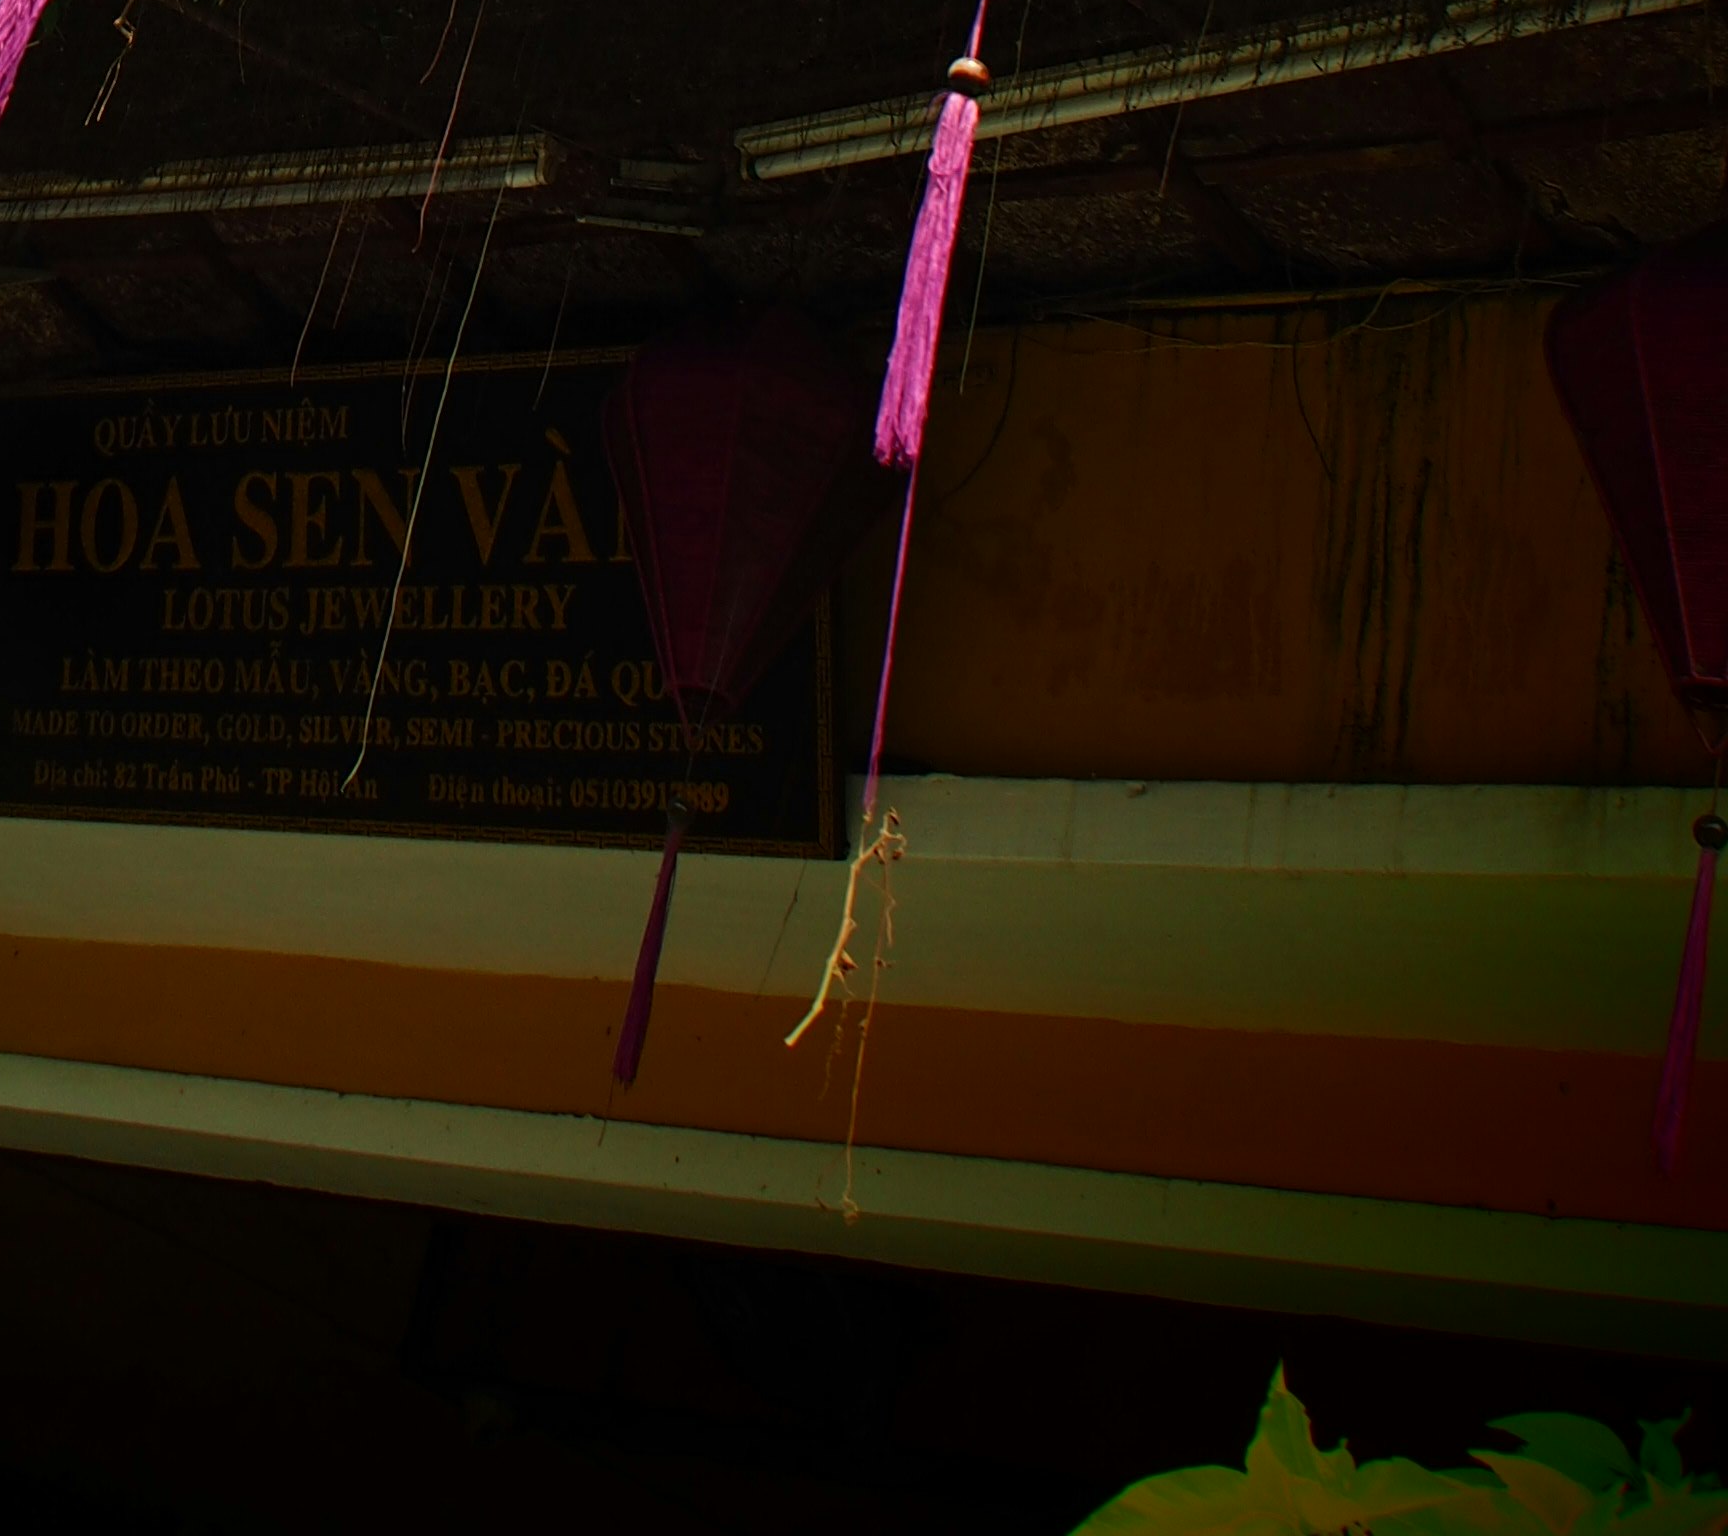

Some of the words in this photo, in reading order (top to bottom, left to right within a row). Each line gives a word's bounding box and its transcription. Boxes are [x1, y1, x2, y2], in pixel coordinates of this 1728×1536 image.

[94, 397, 182, 456] QUẦY
[189, 404, 253, 449] LƯU
[261, 396, 350, 447] NIỆM
[11, 475, 202, 575] HOA
[230, 467, 422, 572] SEN
[448, 426, 634, 568] VÀ
[161, 584, 290, 632] LOTUS
[299, 583, 577, 638] JEWELLERY
[59, 647, 129, 693] LÀM
[139, 657, 225, 695] THEO
[232, 639, 319, 703] MẪU,
[328, 647, 440, 703] VÀNG,
[447, 658, 538, 705] BẠC,
[544, 649, 598, 699] ĐÁ
[610, 659, 665, 708] QU
[12, 709, 79, 736] MADE
[85, 711, 116, 736] TO
[122, 711, 211, 746] ORDER,
[216, 711, 293, 749] GOLD,
[406, 716, 474, 747] SEMI
[495, 718, 641, 752] PRECIOUS
[648, 721, 765, 755] STONES
[113, 762, 138, 789] 82
[200, 765, 241, 794] Phú
[261, 767, 293, 796] TP
